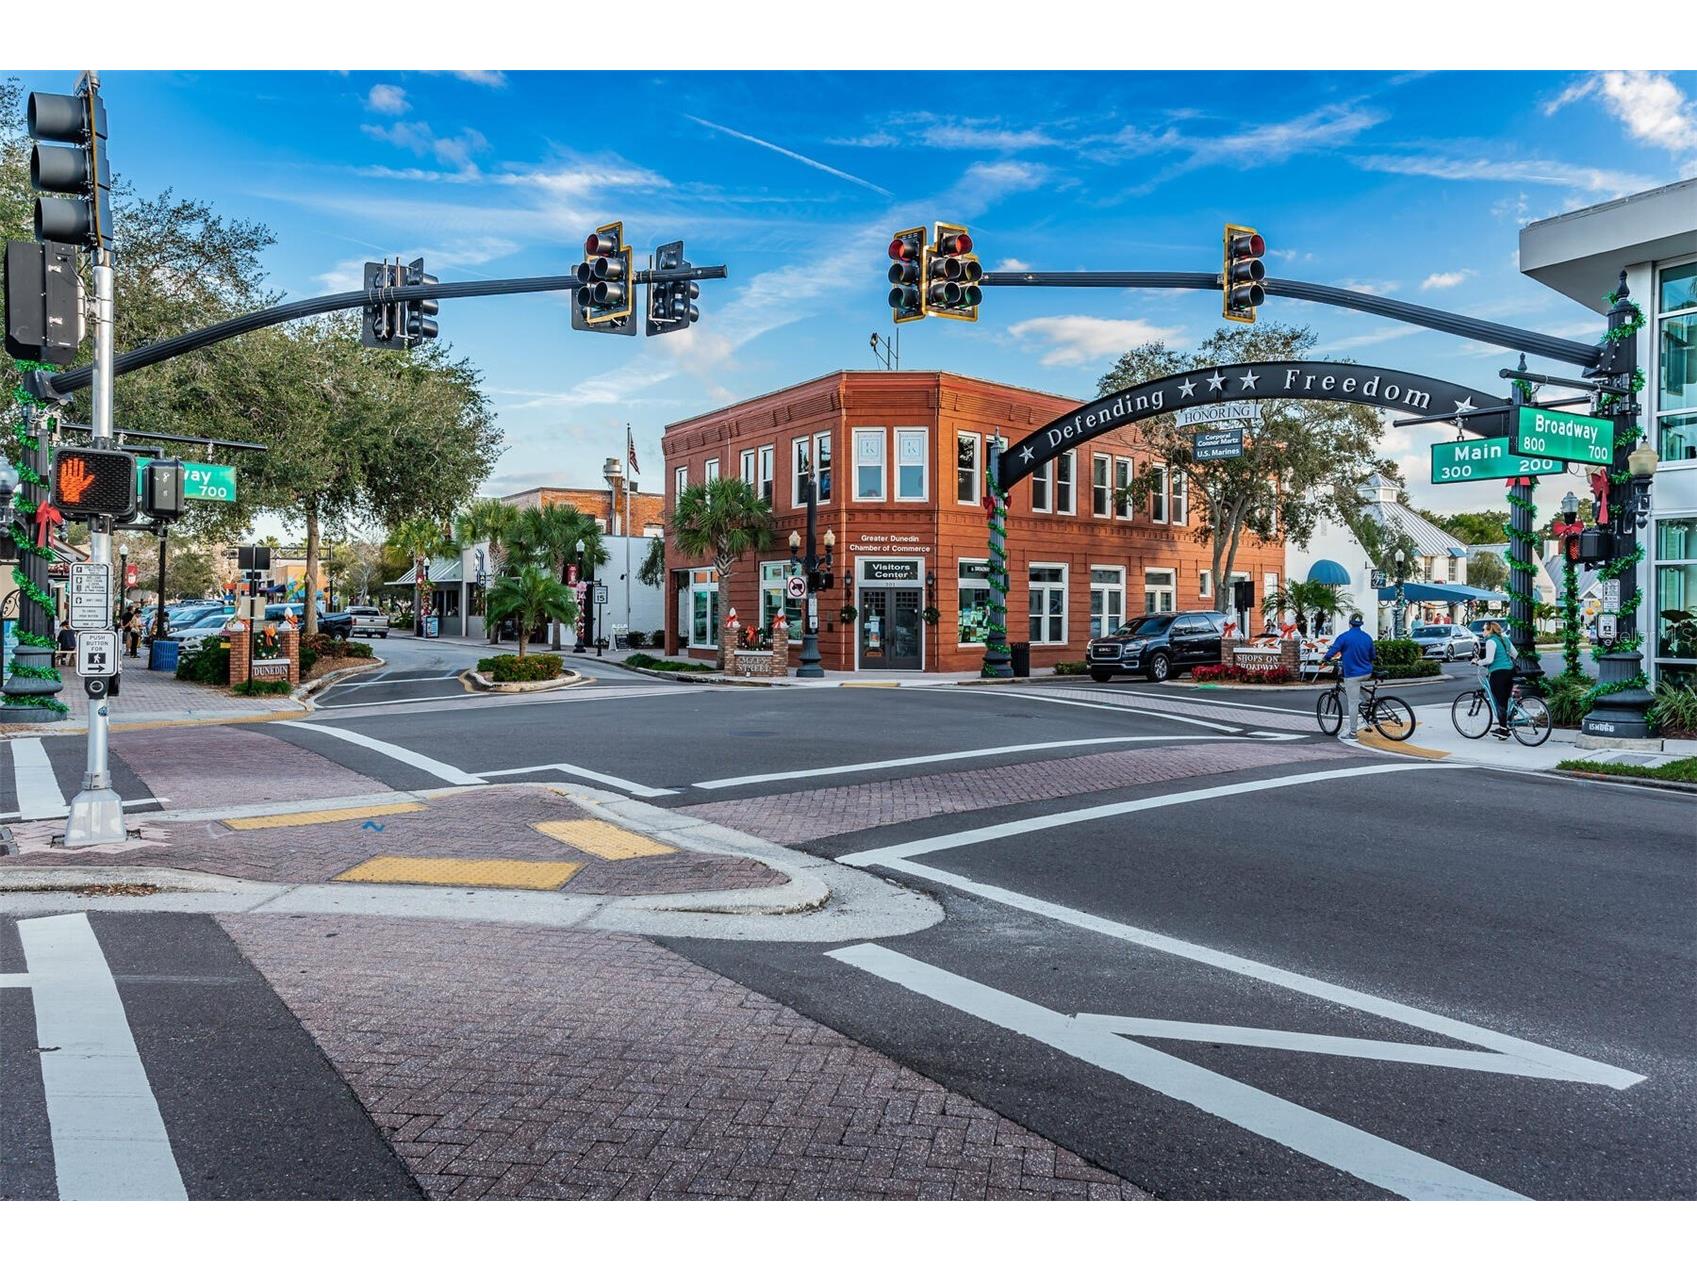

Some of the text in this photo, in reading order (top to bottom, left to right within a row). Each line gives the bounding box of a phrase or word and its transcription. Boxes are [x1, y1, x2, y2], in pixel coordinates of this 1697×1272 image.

[1046, 369, 1431, 448] Defending Freedom
[1184, 405, 1250, 423] HONORING
[1535, 414, 1598, 443] Broadway
[1205, 433, 1231, 441] Corporal
[1197, 439, 1220, 447] Connor
[1523, 437, 1608, 460] 800 700
[1197, 448, 1240, 458] U.S. Marines
[1454, 444, 1502, 462] Main
[1441, 459, 1553, 479] 300 200
[199, 485, 227, 498] 700
[861, 534, 888, 542] Greater
[849, 543, 881, 552] Chamber
[882, 544, 890, 552] of
[872, 563, 910, 571] Visitors
[1236, 654, 1279, 663] SHOPS ON
[254, 665, 288, 676] DUNEDIN
